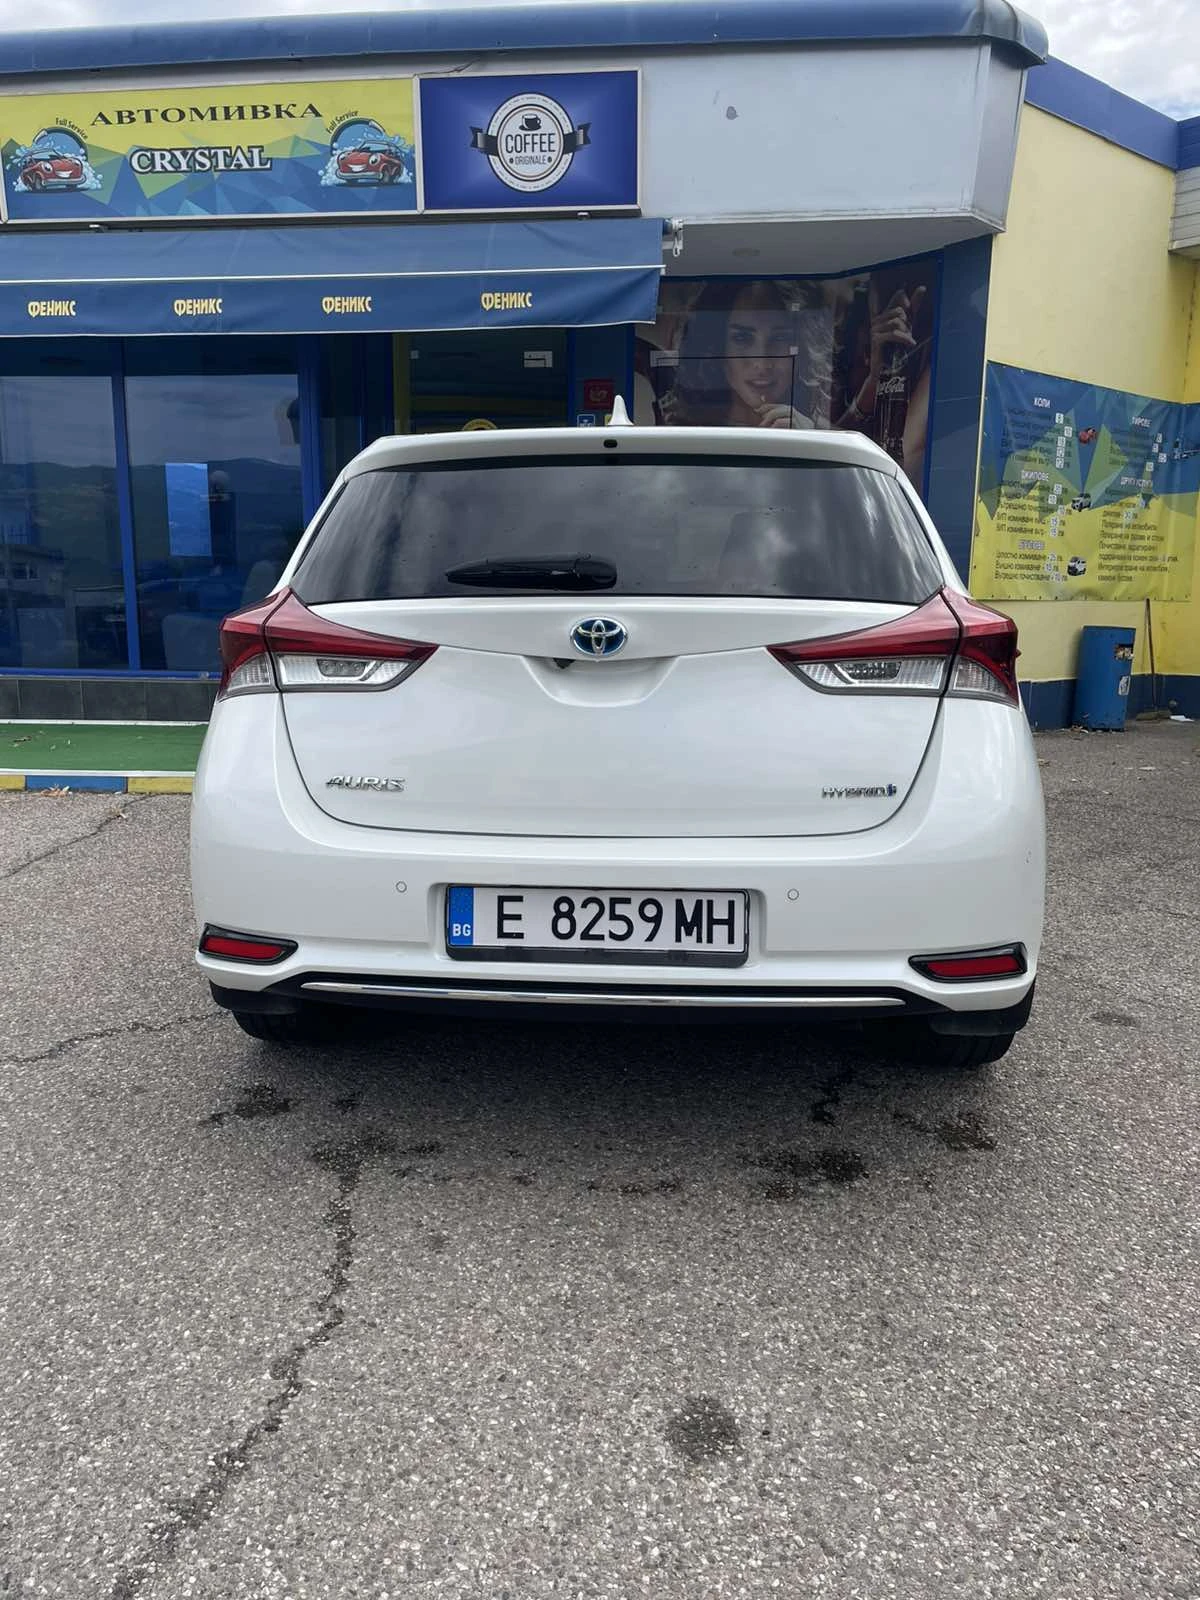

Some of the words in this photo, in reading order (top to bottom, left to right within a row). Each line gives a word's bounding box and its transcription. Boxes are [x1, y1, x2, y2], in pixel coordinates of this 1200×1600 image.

[91, 103, 323, 126] АВТОМИВКА
[334, 111, 360, 126] Service
[56, 117, 68, 127] Full
[68, 120, 89, 140] Service
[505, 133, 556, 153] COFFEE
[131, 146, 272, 173] CRYSTAL
[514, 155, 547, 165] ORIGINALE
[28, 300, 76, 317] ФЕНИКС
[174, 298, 223, 316] ФЕНИКС
[322, 296, 372, 314] ФЕНИКС
[481, 292, 533, 311] ФЕНИКС
[325, 776, 405, 792] AURIS
[822, 786, 887, 798] HYBRID
[497, 895, 525, 940] E
[551, 896, 664, 943] 8259
[675, 898, 735, 945] MH
[452, 924, 471, 937] BG
